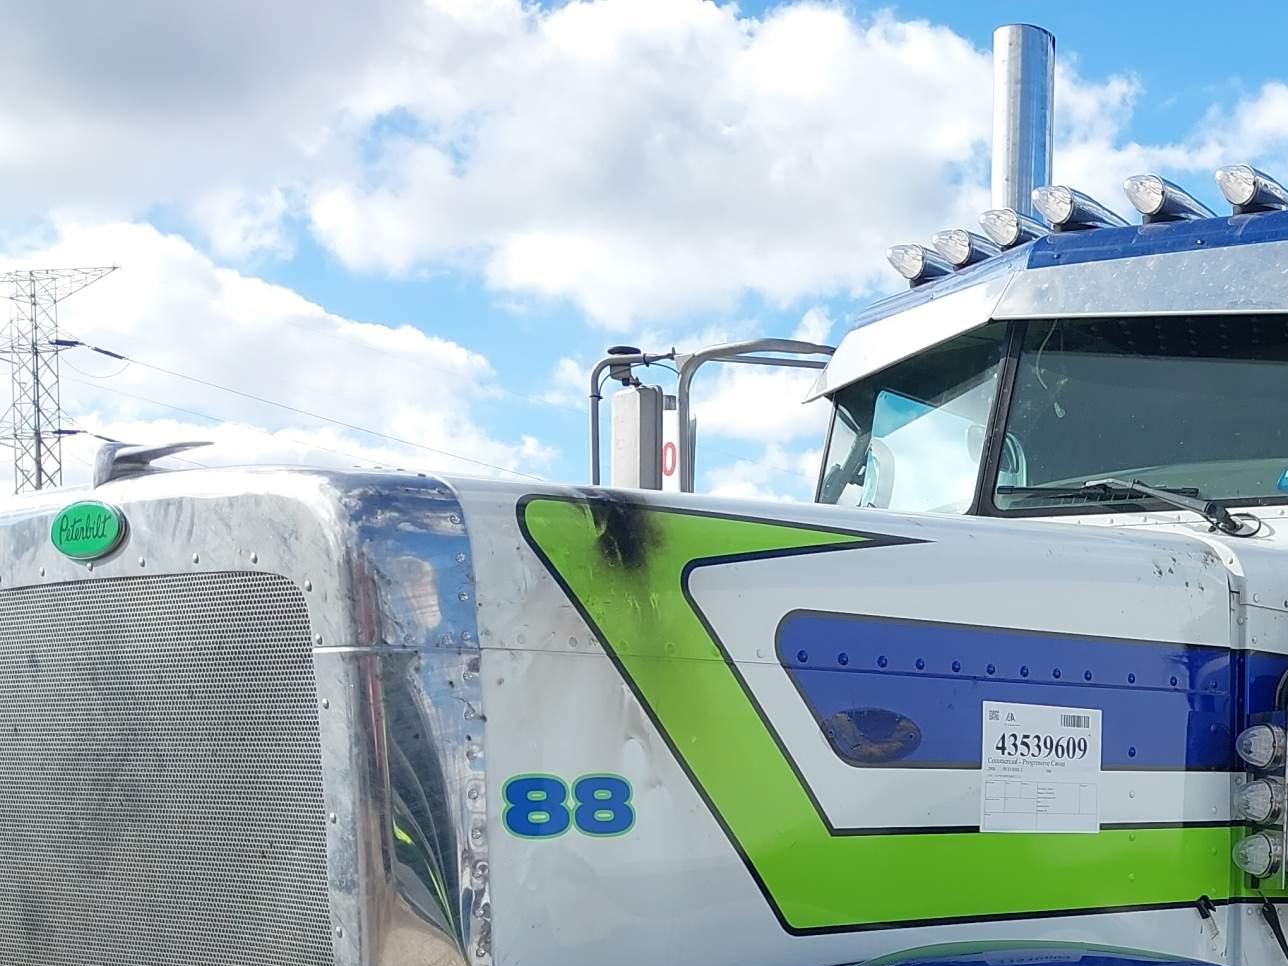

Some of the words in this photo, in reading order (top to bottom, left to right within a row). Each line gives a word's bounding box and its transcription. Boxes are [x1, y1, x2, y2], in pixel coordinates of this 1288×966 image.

[59, 513, 112, 545] Peterbilt
[995, 732, 1088, 760] 43539609
[501, 772, 636, 840] 88
